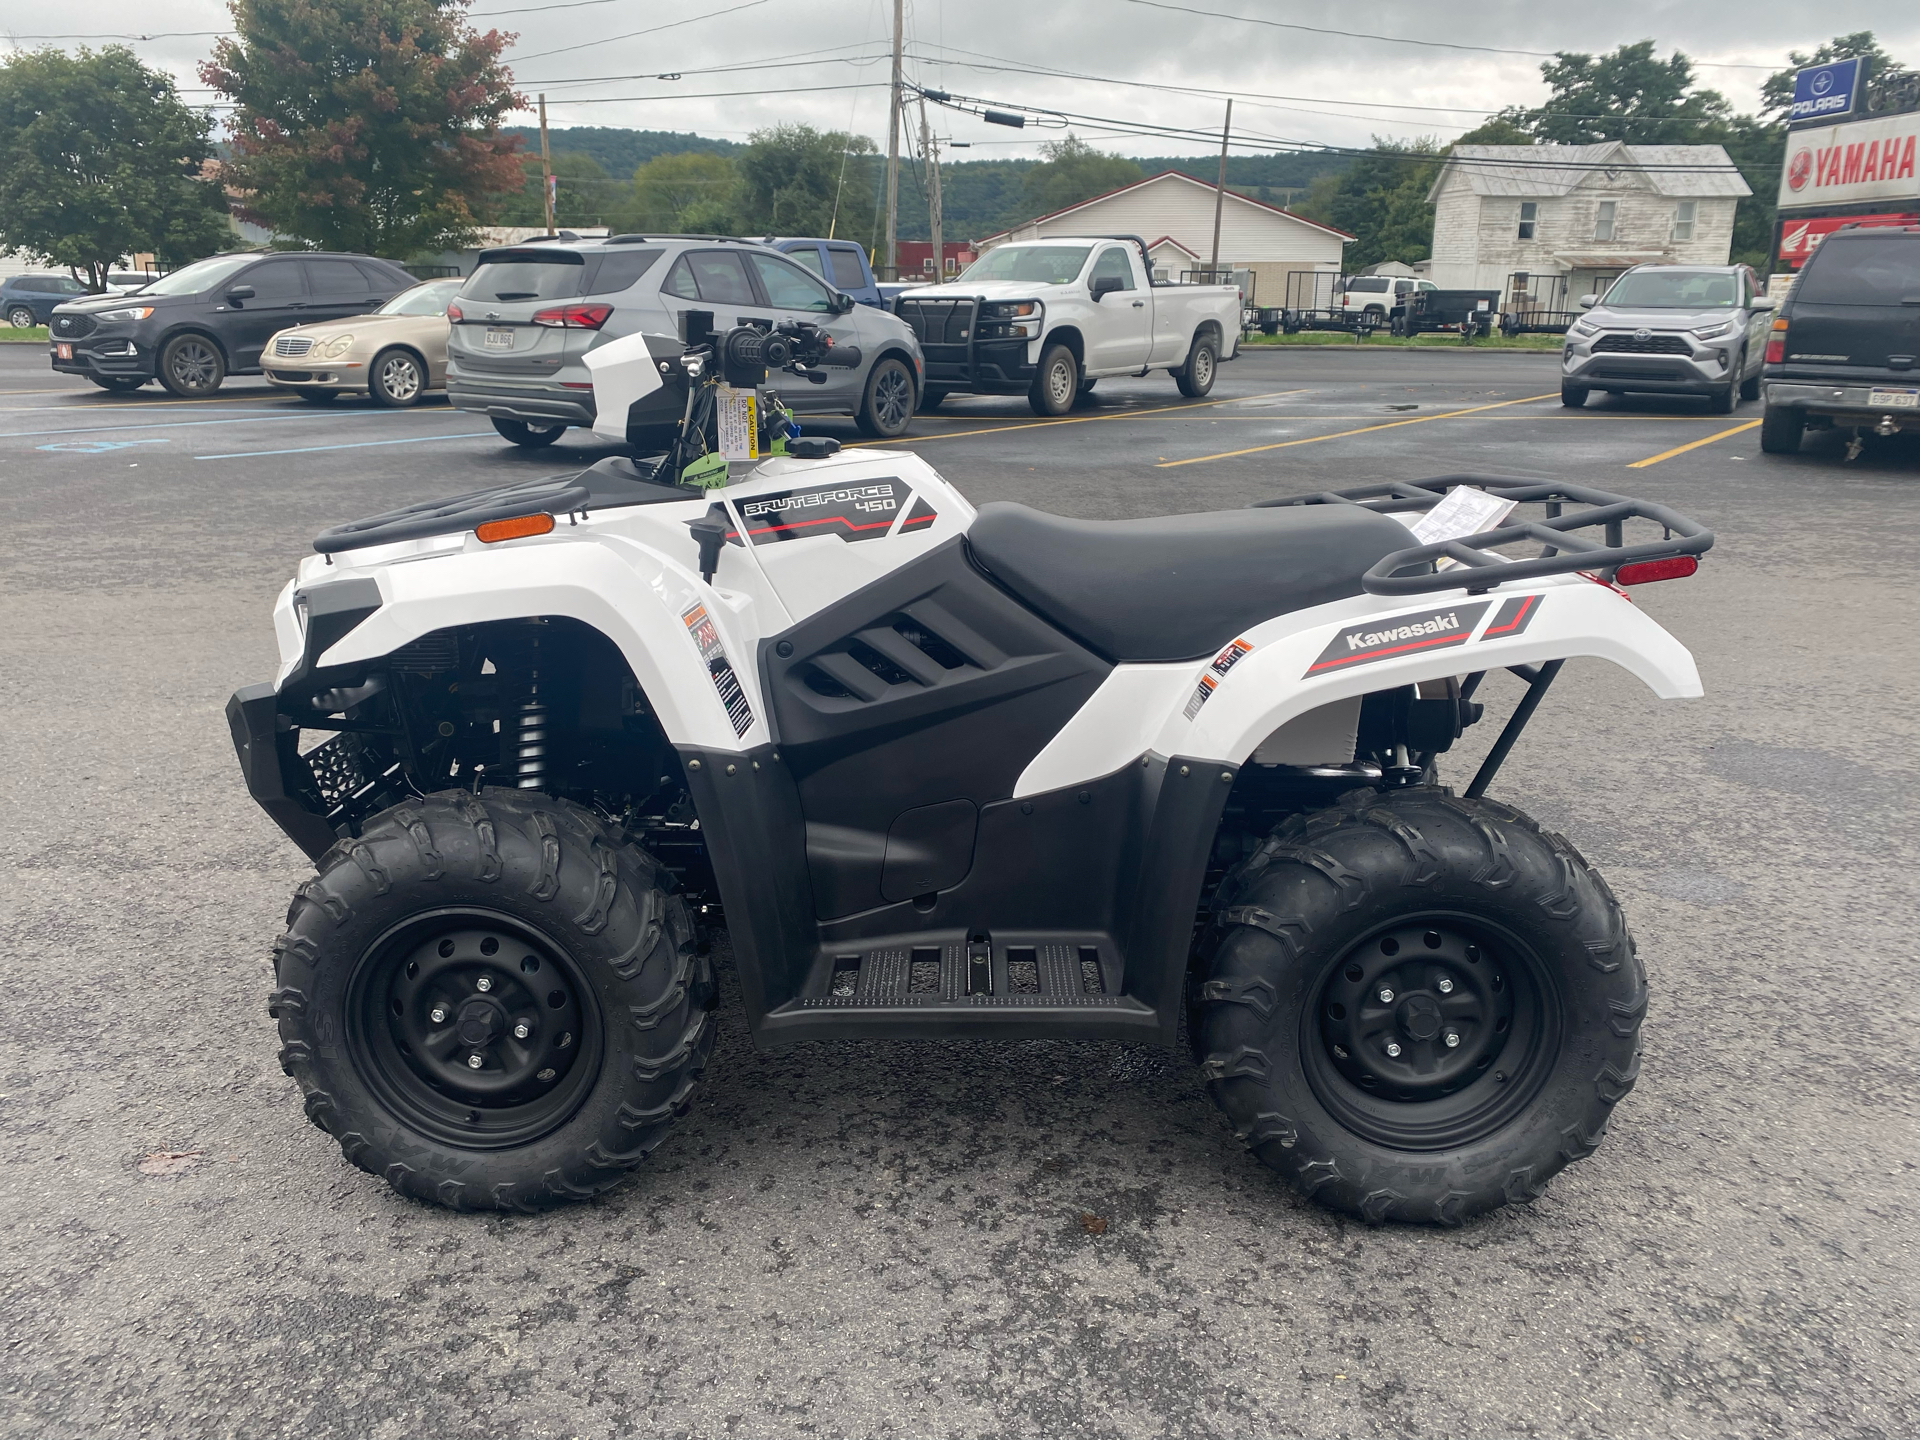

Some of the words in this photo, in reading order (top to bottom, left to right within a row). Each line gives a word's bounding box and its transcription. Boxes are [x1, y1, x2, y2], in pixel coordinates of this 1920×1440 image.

[1792, 94, 1847, 116] POLARIS
[1815, 136, 1916, 187] YAMAHA
[742, 399, 746, 408] DO
[855, 498, 896, 512] 450
[1346, 612, 1460, 650] Kawasaki
[315, 1012, 475, 1174] MAXXIS
